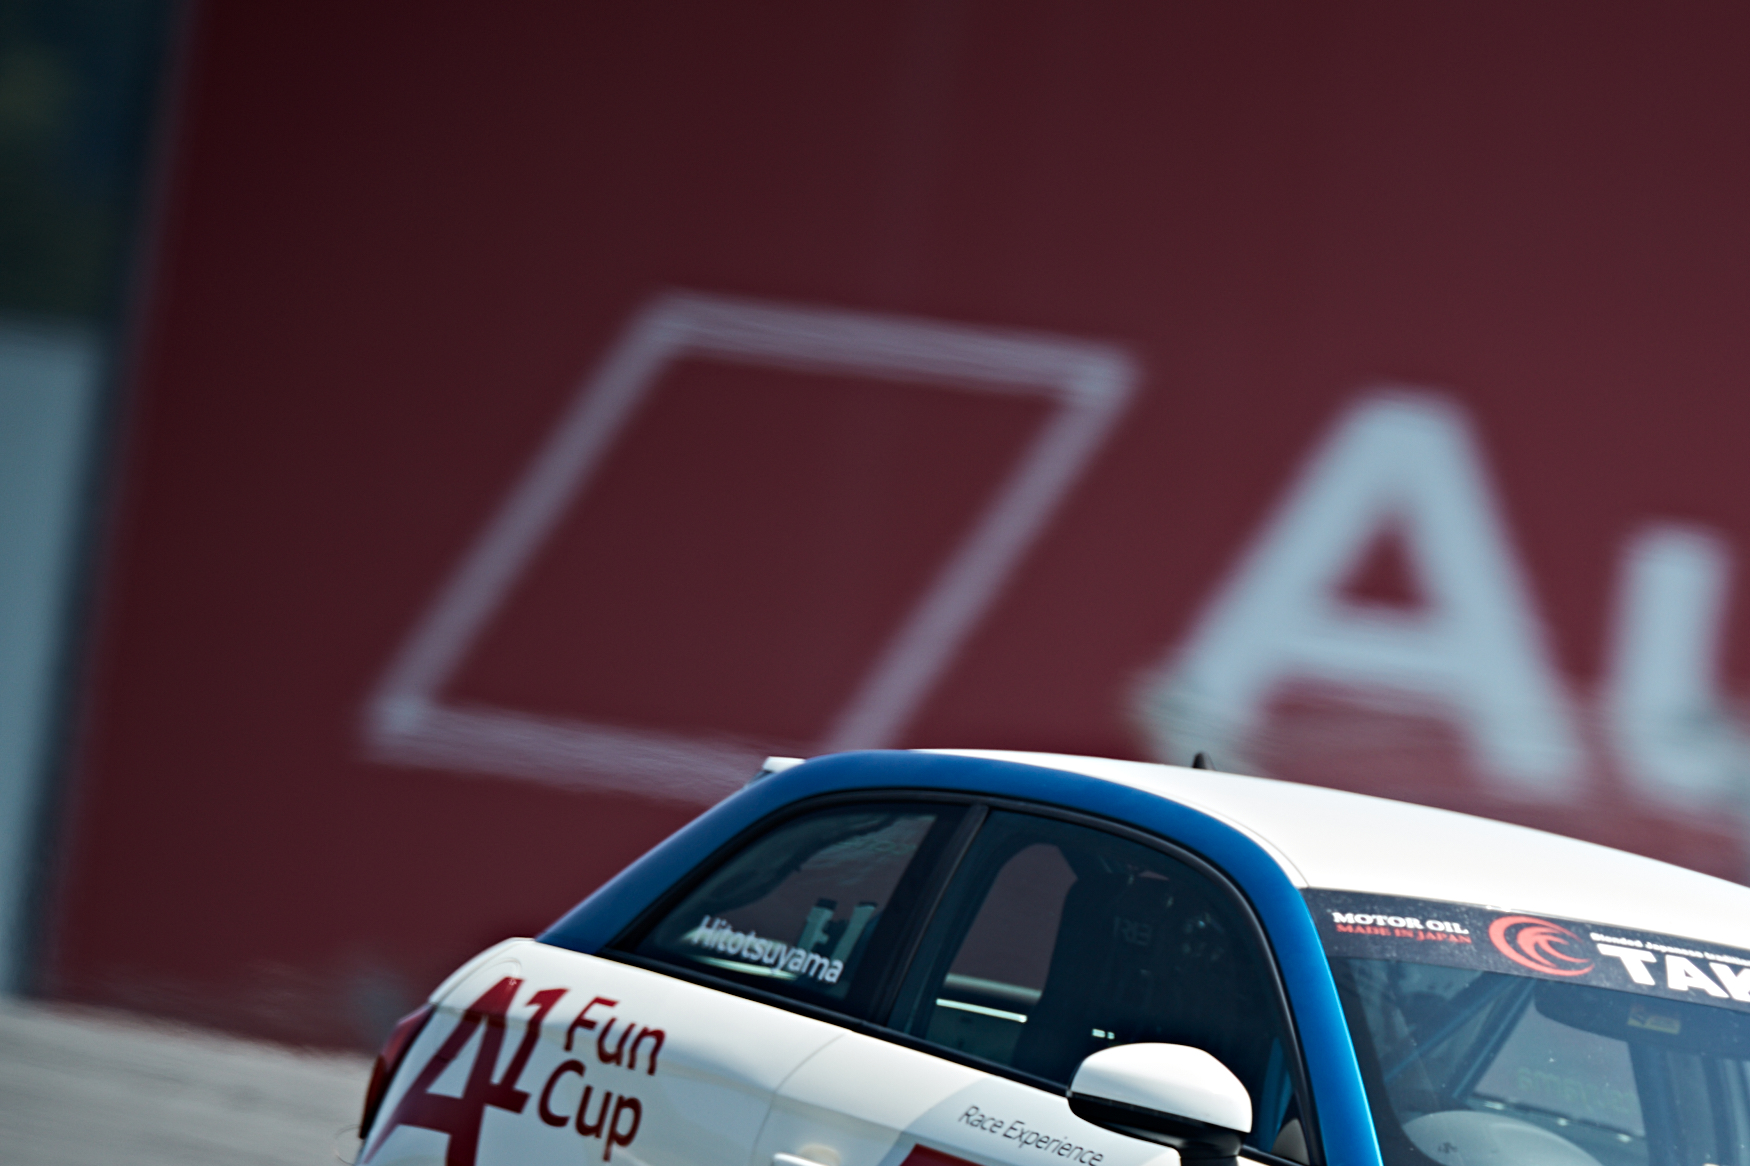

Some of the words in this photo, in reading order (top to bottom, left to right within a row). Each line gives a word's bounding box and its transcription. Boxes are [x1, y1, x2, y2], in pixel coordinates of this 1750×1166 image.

[1331, 911, 1424, 930] MOTOR
[1426, 920, 1470, 935] OIL
[1336, 923, 1391, 937] MADE
[1391, 927, 1415, 939] IN
[1416, 929, 1472, 944] JAPAN
[690, 914, 845, 984] Hitotsuyama
[563, 996, 666, 1076] Fun
[537, 1059, 643, 1162] Cup
[957, 1104, 1004, 1135] Race
